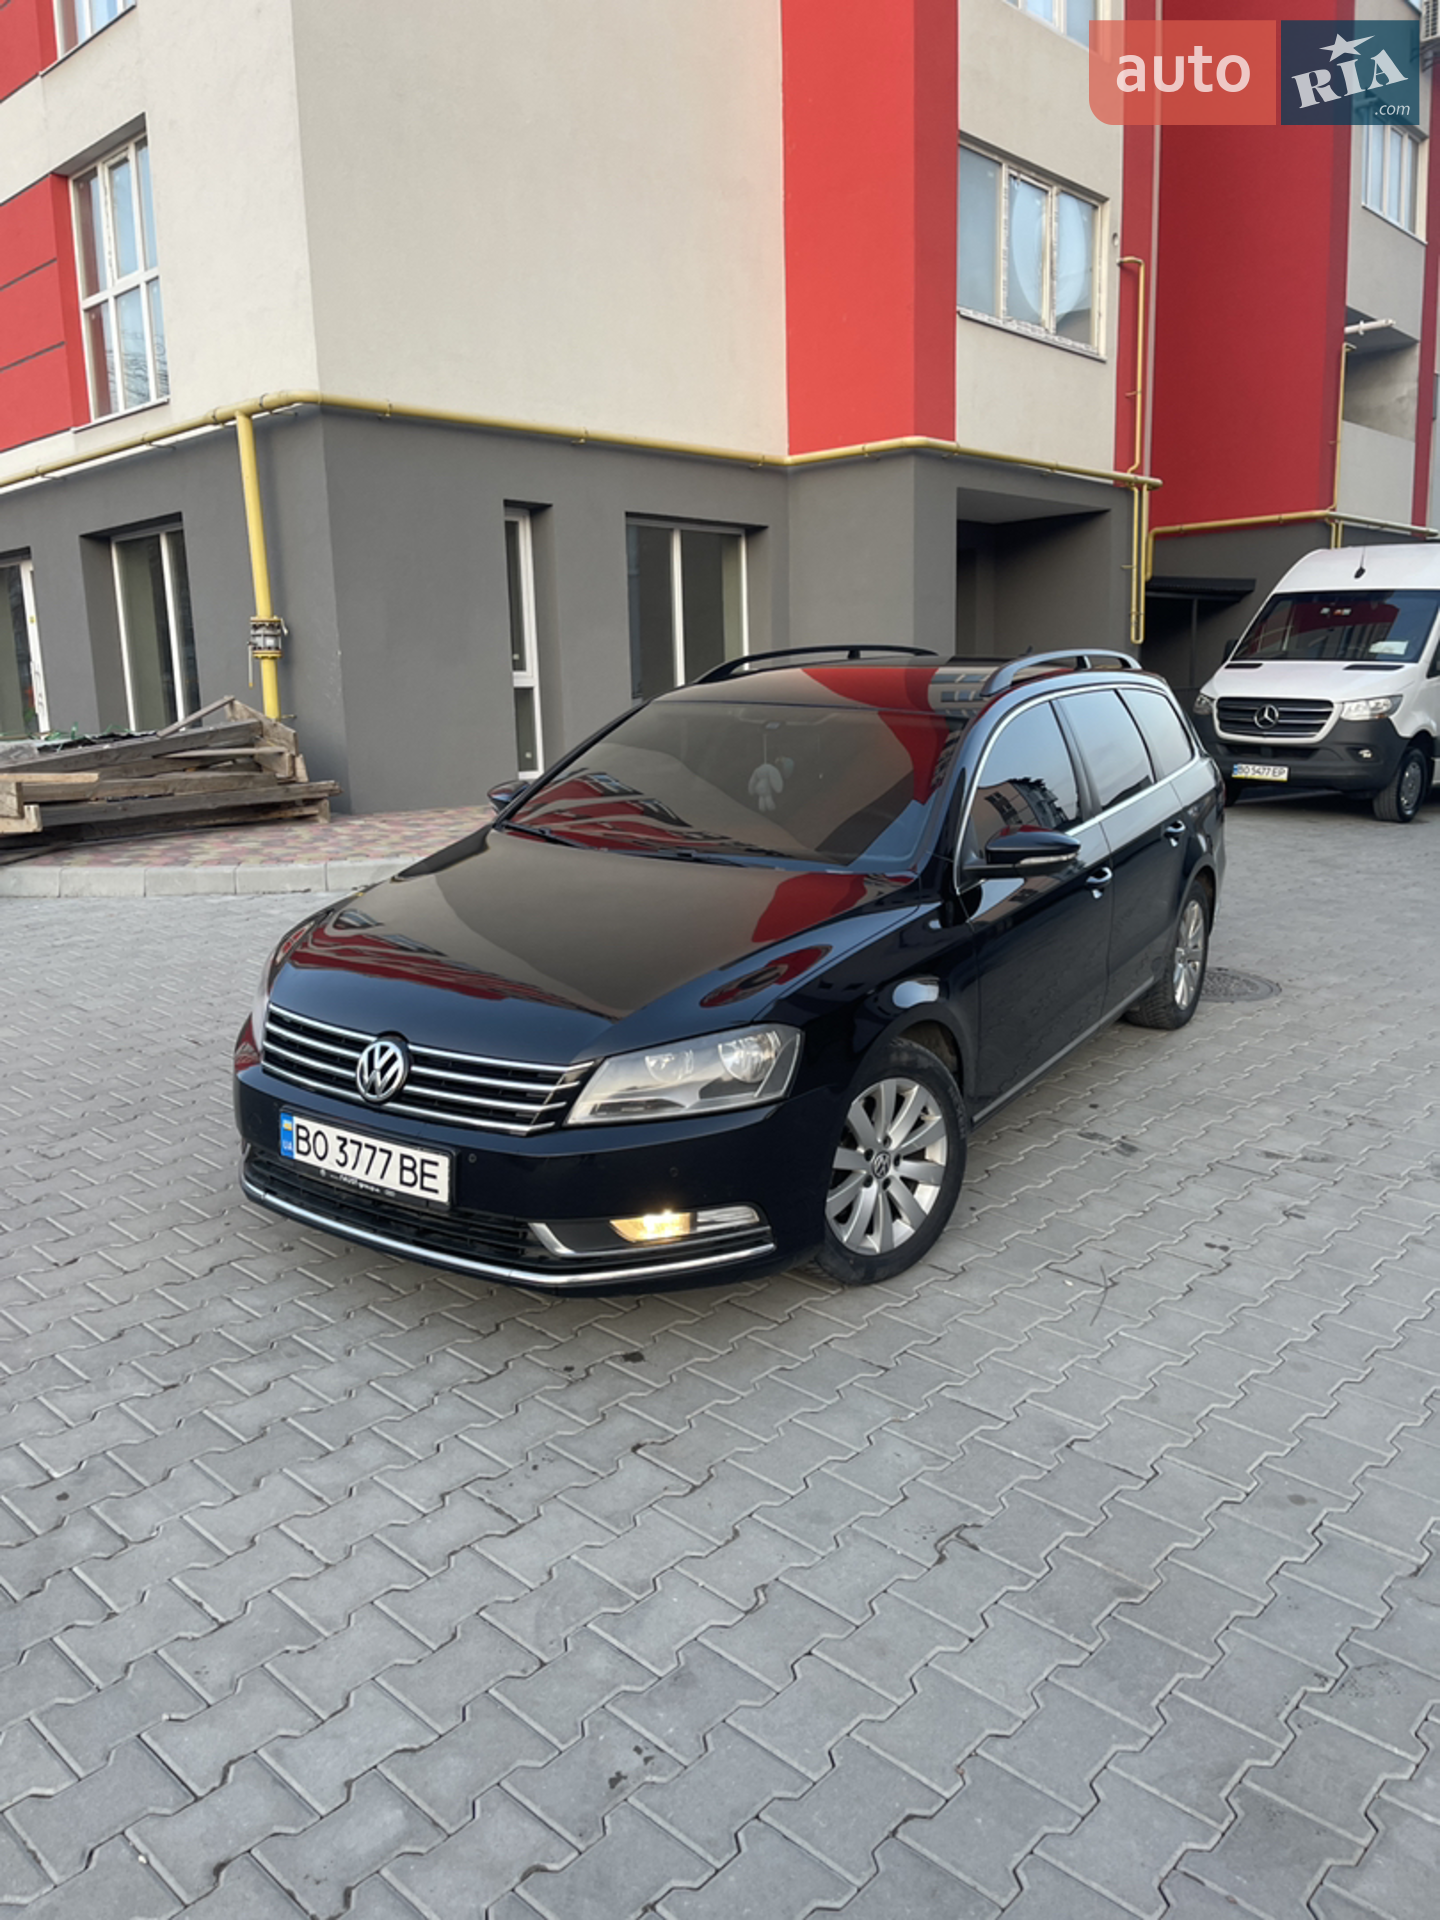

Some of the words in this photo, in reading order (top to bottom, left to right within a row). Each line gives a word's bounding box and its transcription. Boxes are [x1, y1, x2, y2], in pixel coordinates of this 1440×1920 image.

[296, 1123, 328, 1161] BO
[336, 1135, 392, 1180] 3777
[399, 1154, 440, 1194] BE
